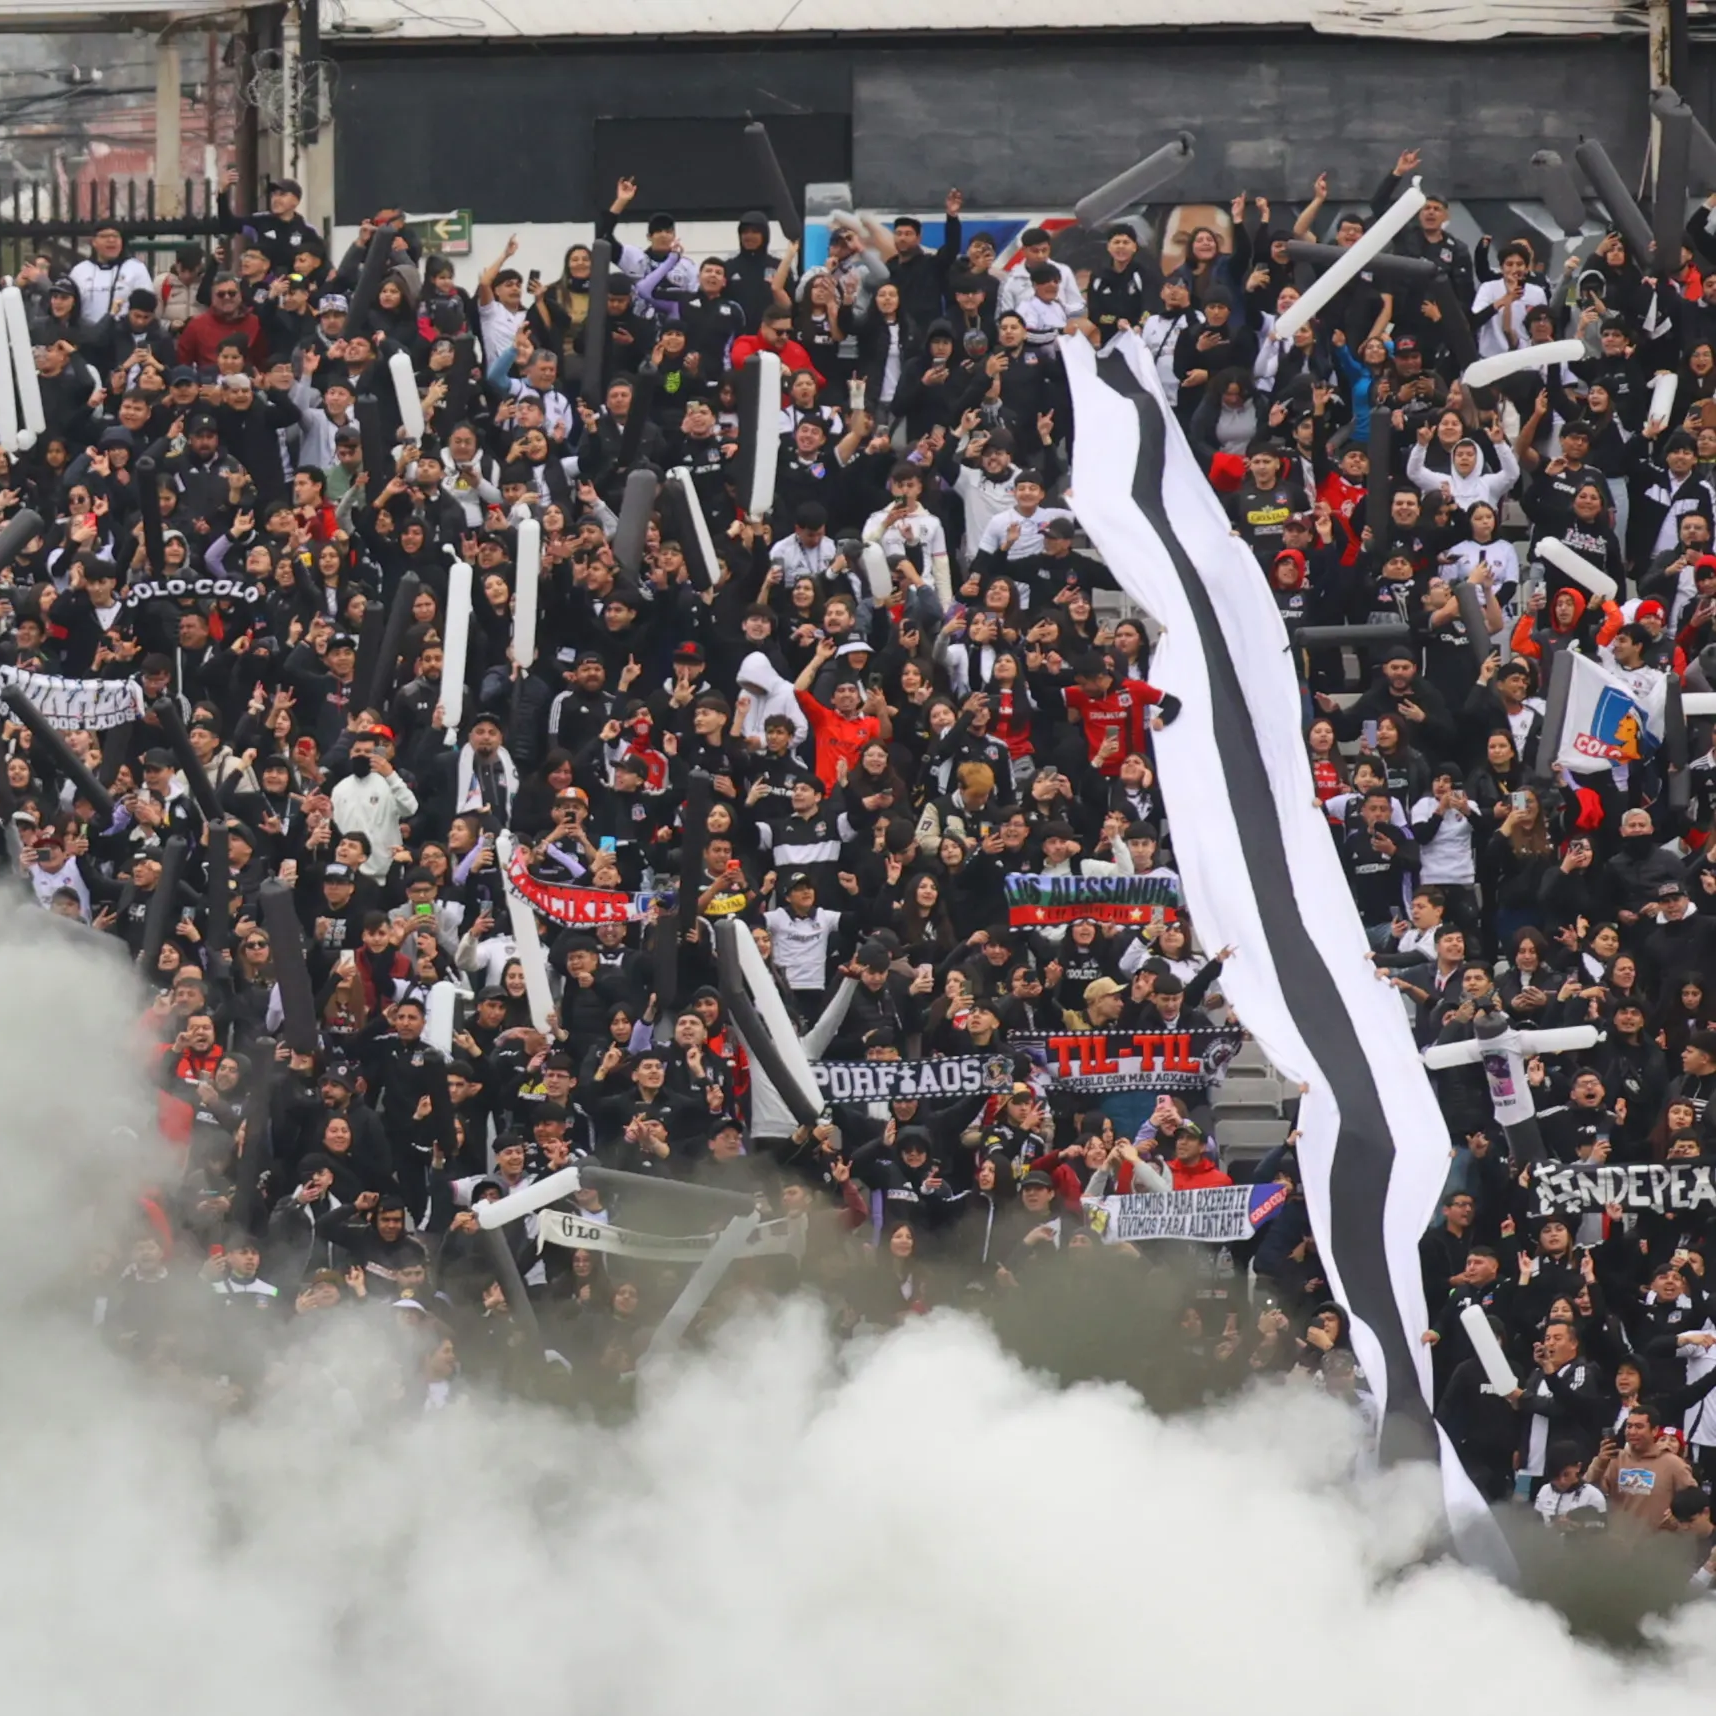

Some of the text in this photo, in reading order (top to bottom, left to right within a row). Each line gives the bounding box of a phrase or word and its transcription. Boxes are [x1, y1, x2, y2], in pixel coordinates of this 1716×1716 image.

[1048, 1034, 1200, 1078] TIL-TIL
[1106, 1075, 1128, 1085] CON
[1120, 1193, 1164, 1215] NACIMOS
[1166, 1191, 1193, 1214] PARA
[1118, 1211, 1245, 1238] VIVIMOS PARA ALENTARTE
